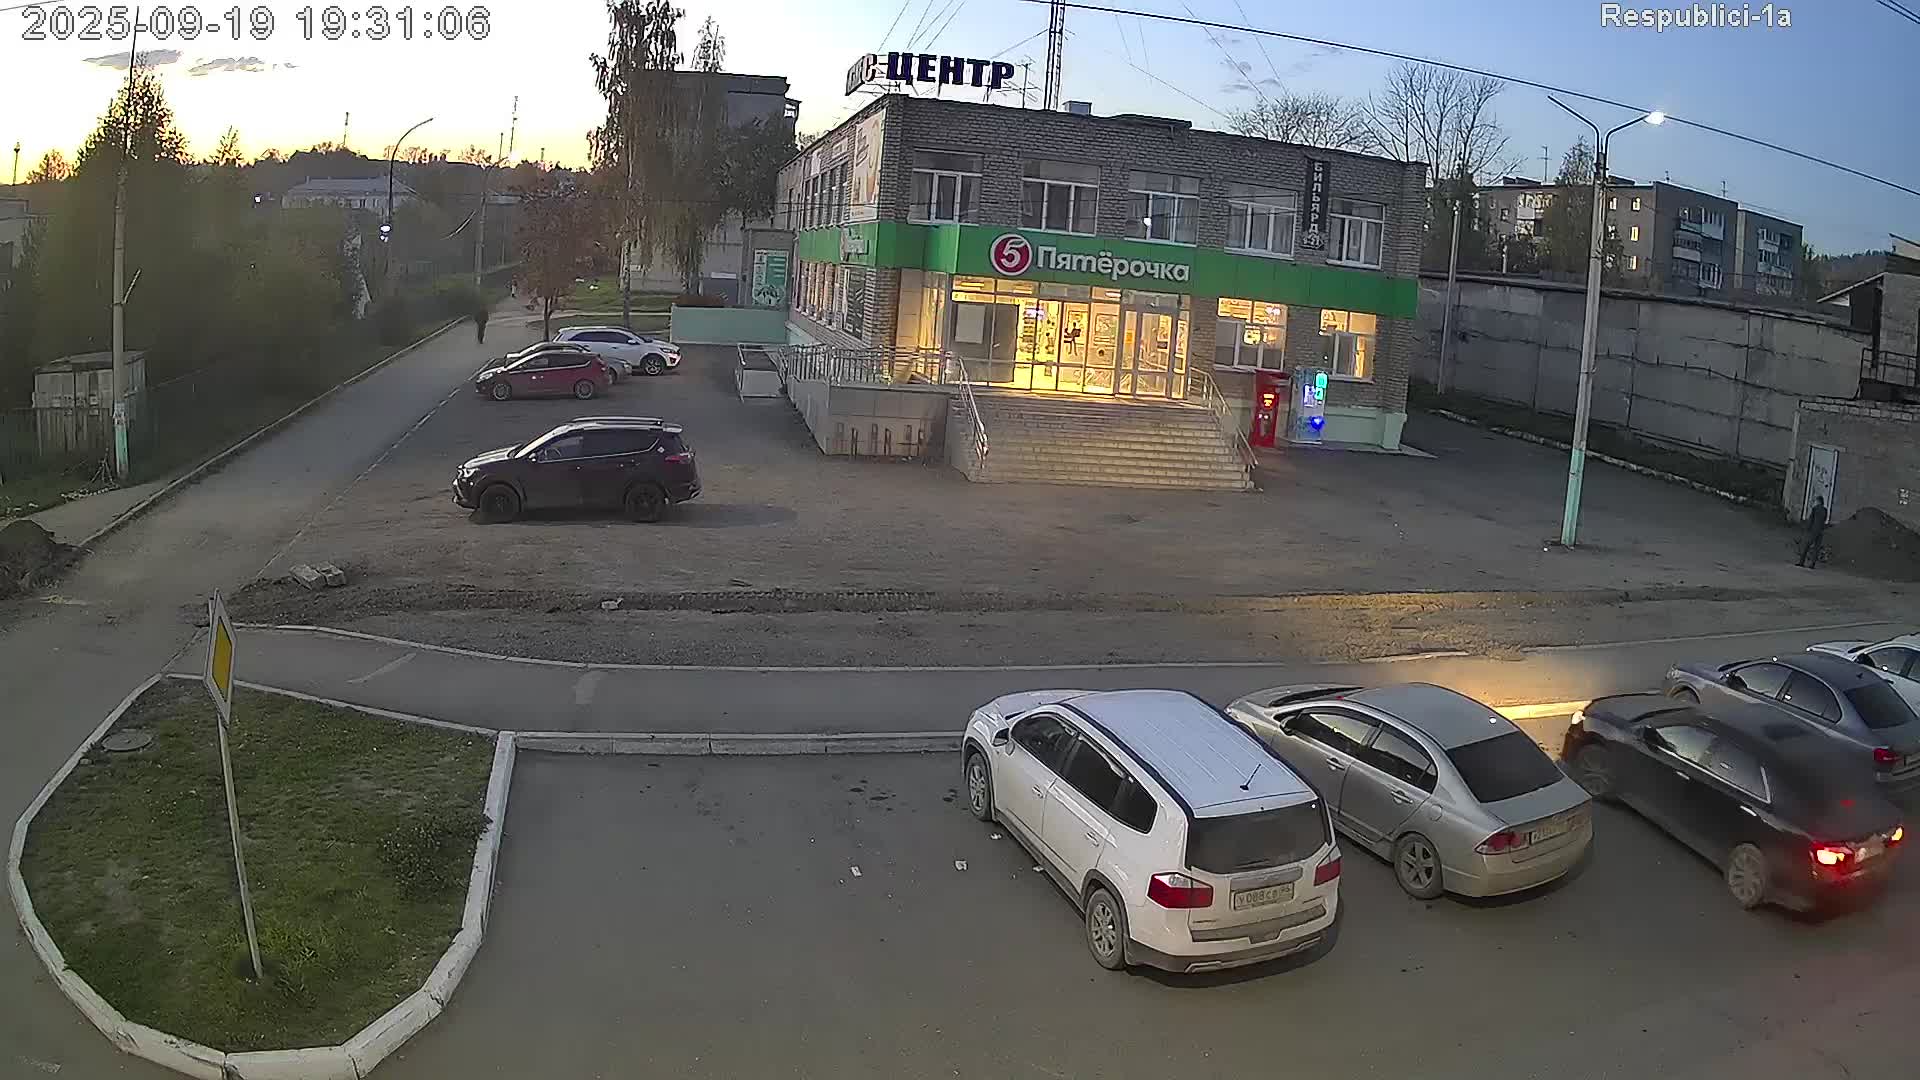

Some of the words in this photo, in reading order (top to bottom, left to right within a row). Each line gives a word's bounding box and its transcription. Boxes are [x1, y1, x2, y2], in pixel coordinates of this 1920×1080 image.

[887, 51, 1015, 90] ЦЕНТР
[1308, 162, 1323, 233] БИЛЬЯРД
[1000, 238, 1025, 268] 5
[1036, 245, 1190, 281] Пятёрочка
